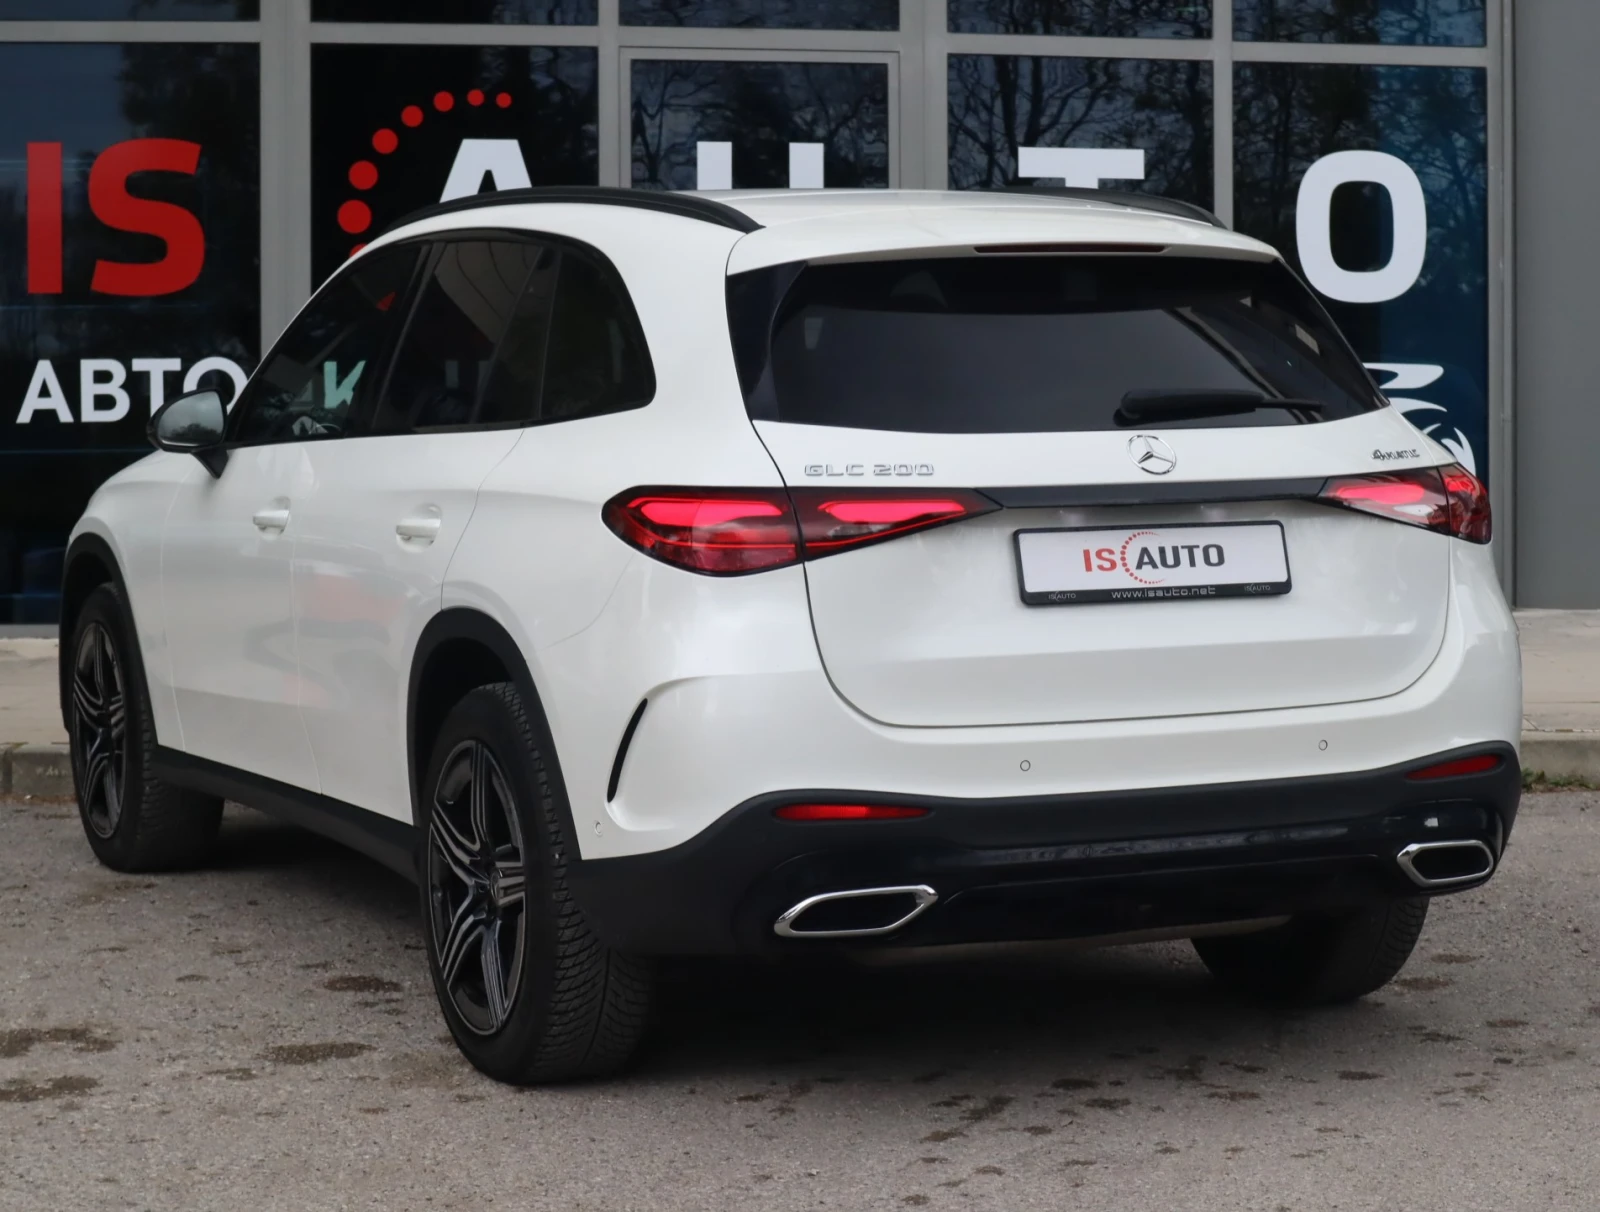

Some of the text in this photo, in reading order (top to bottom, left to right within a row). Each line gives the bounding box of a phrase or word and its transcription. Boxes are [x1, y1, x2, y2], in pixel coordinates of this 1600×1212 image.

[26, 137, 206, 297] IS
[804, 463, 935, 477] GLC 200
[1135, 543, 1226, 571] AUTO
[1111, 585, 1217, 599] www.isauto.net
